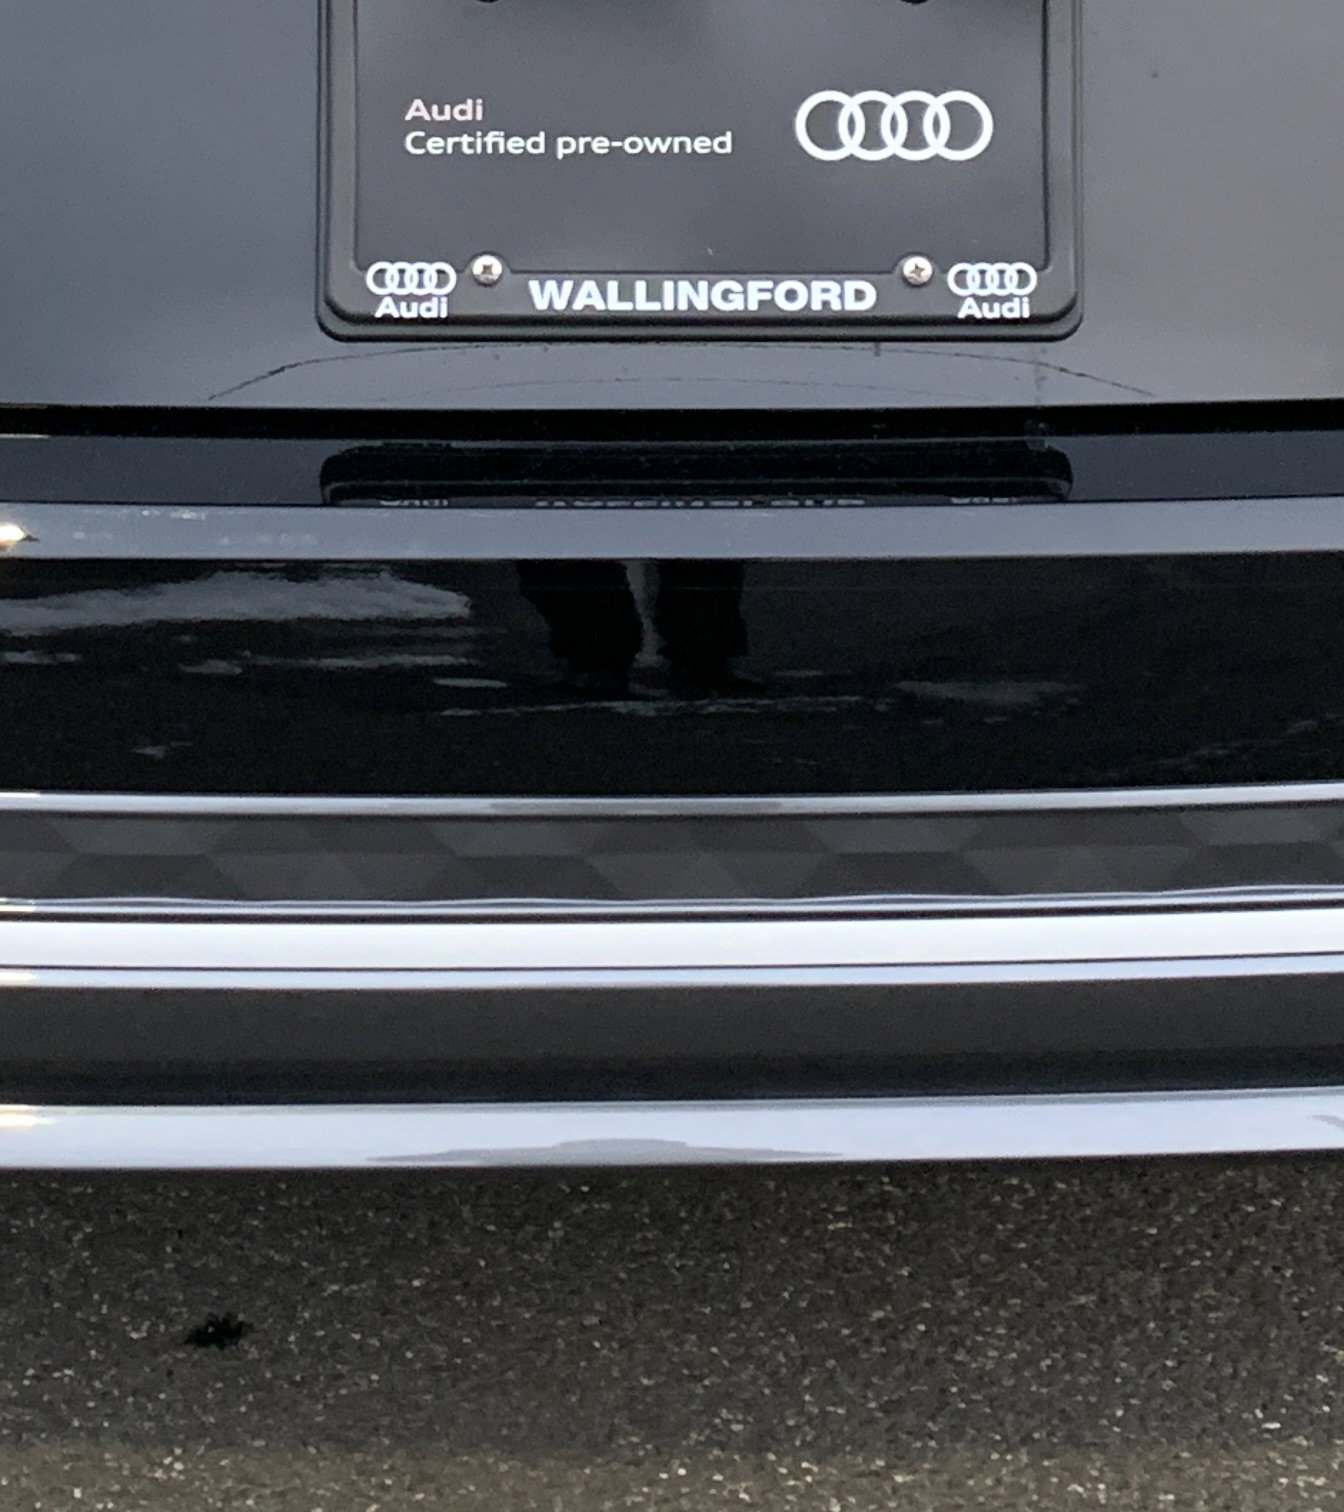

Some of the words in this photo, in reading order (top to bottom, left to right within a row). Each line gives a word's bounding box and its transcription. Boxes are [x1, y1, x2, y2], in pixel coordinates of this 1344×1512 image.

[405, 98, 484, 122] Audi
[405, 130, 546, 155] Certified
[557, 131, 733, 160] pre-owned
[529, 280, 877, 311] WALLINGFORD
[375, 296, 448, 320] Audi
[958, 296, 1030, 320] Audi
